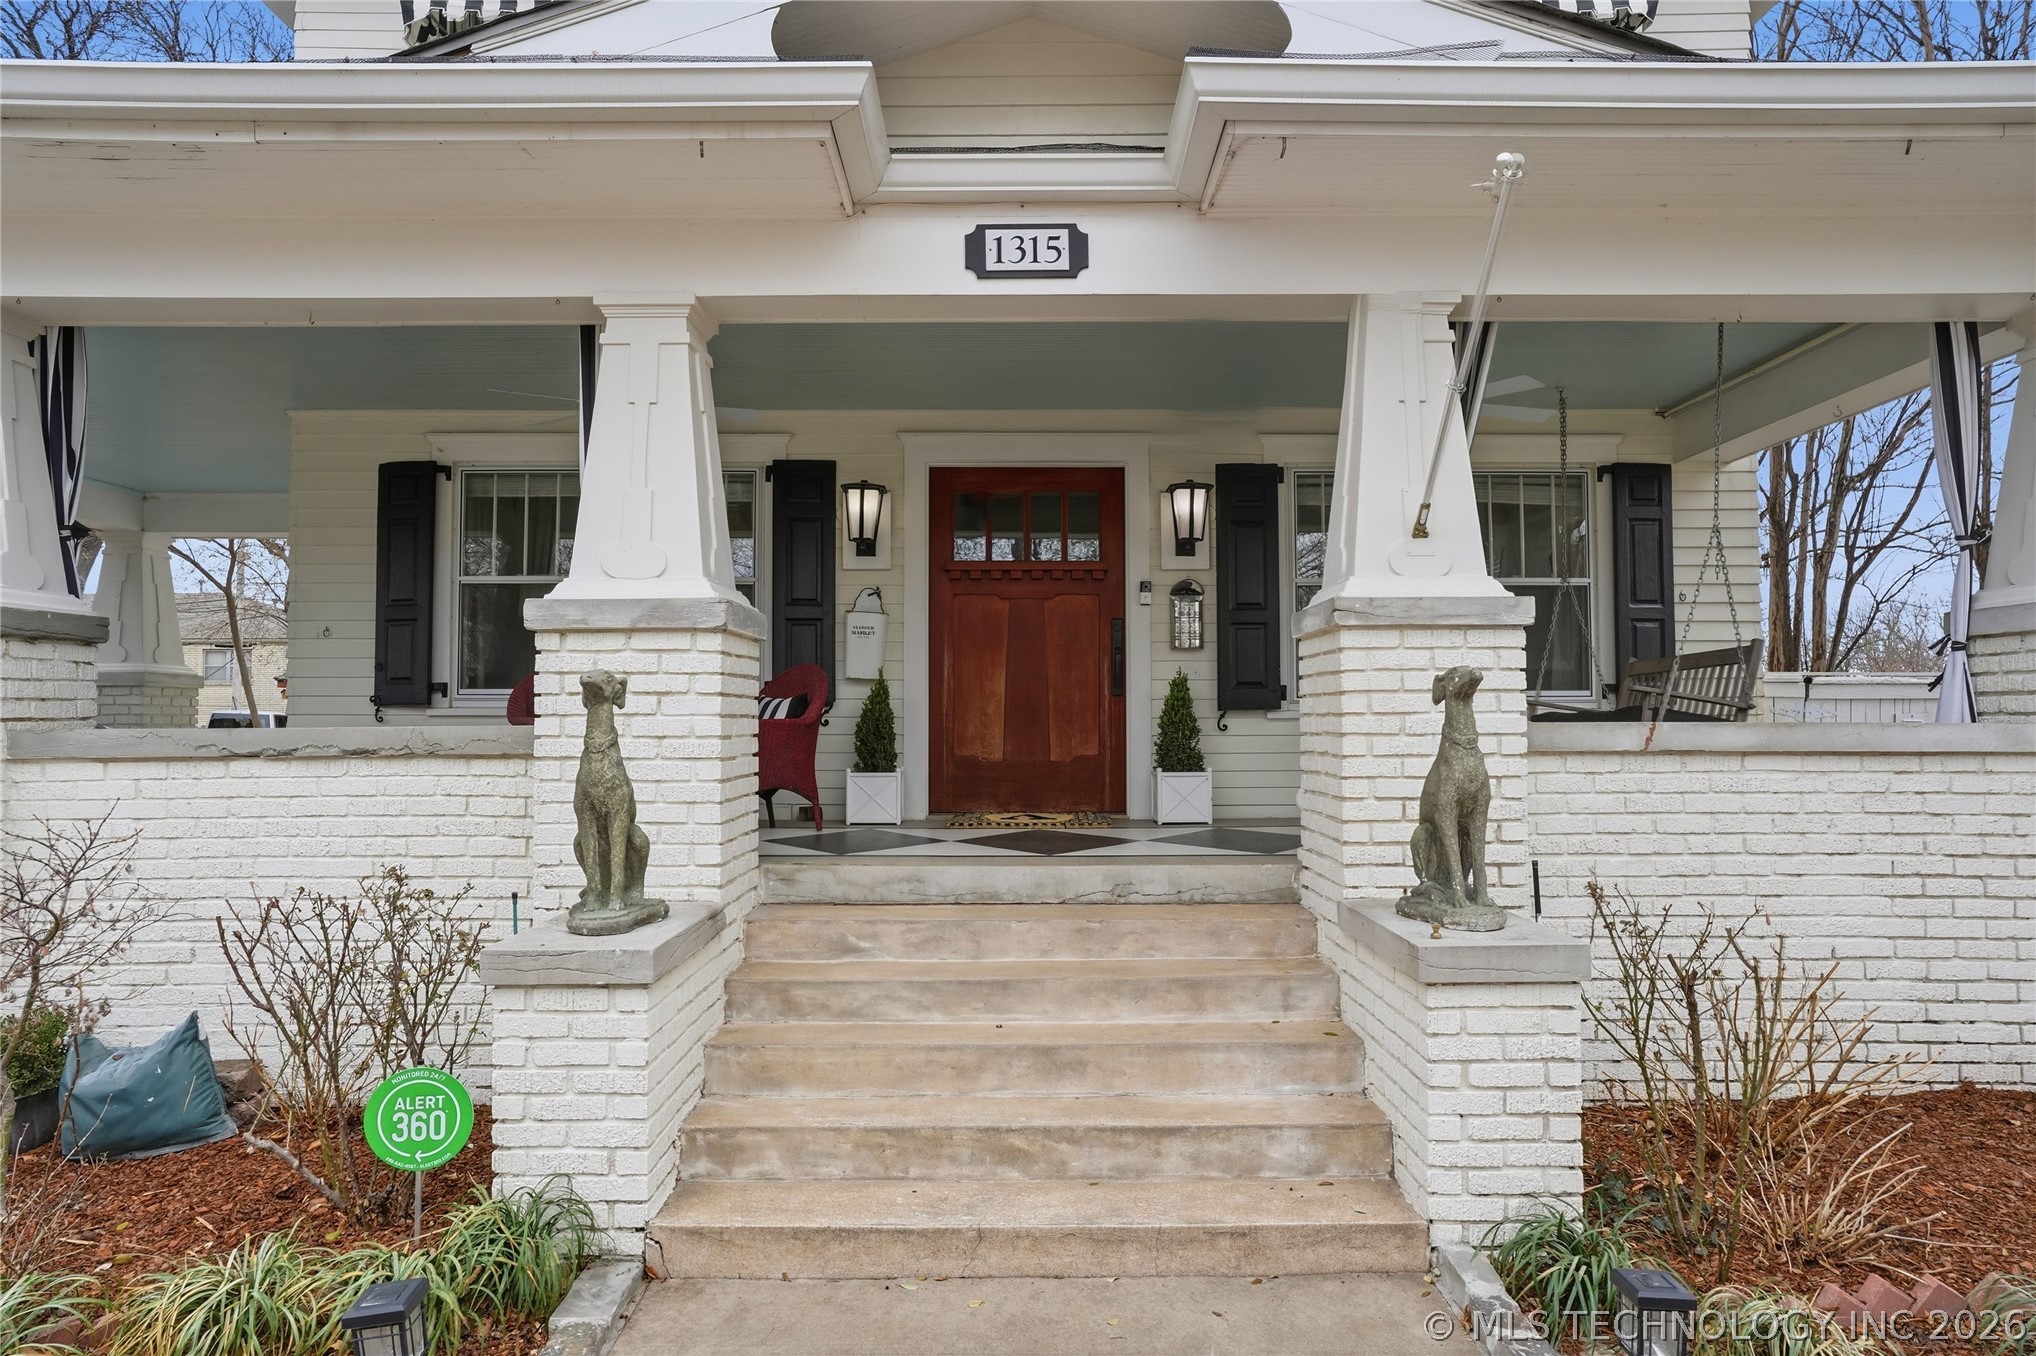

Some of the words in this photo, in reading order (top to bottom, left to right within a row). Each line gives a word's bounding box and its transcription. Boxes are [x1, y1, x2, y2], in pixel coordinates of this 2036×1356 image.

[992, 235, 1062, 264] 1315
[391, 1071, 429, 1084] MONITORED
[430, 1072, 446, 1081] 24/7
[394, 1096, 445, 1110] ALERT
[392, 1110, 446, 1142] 360
